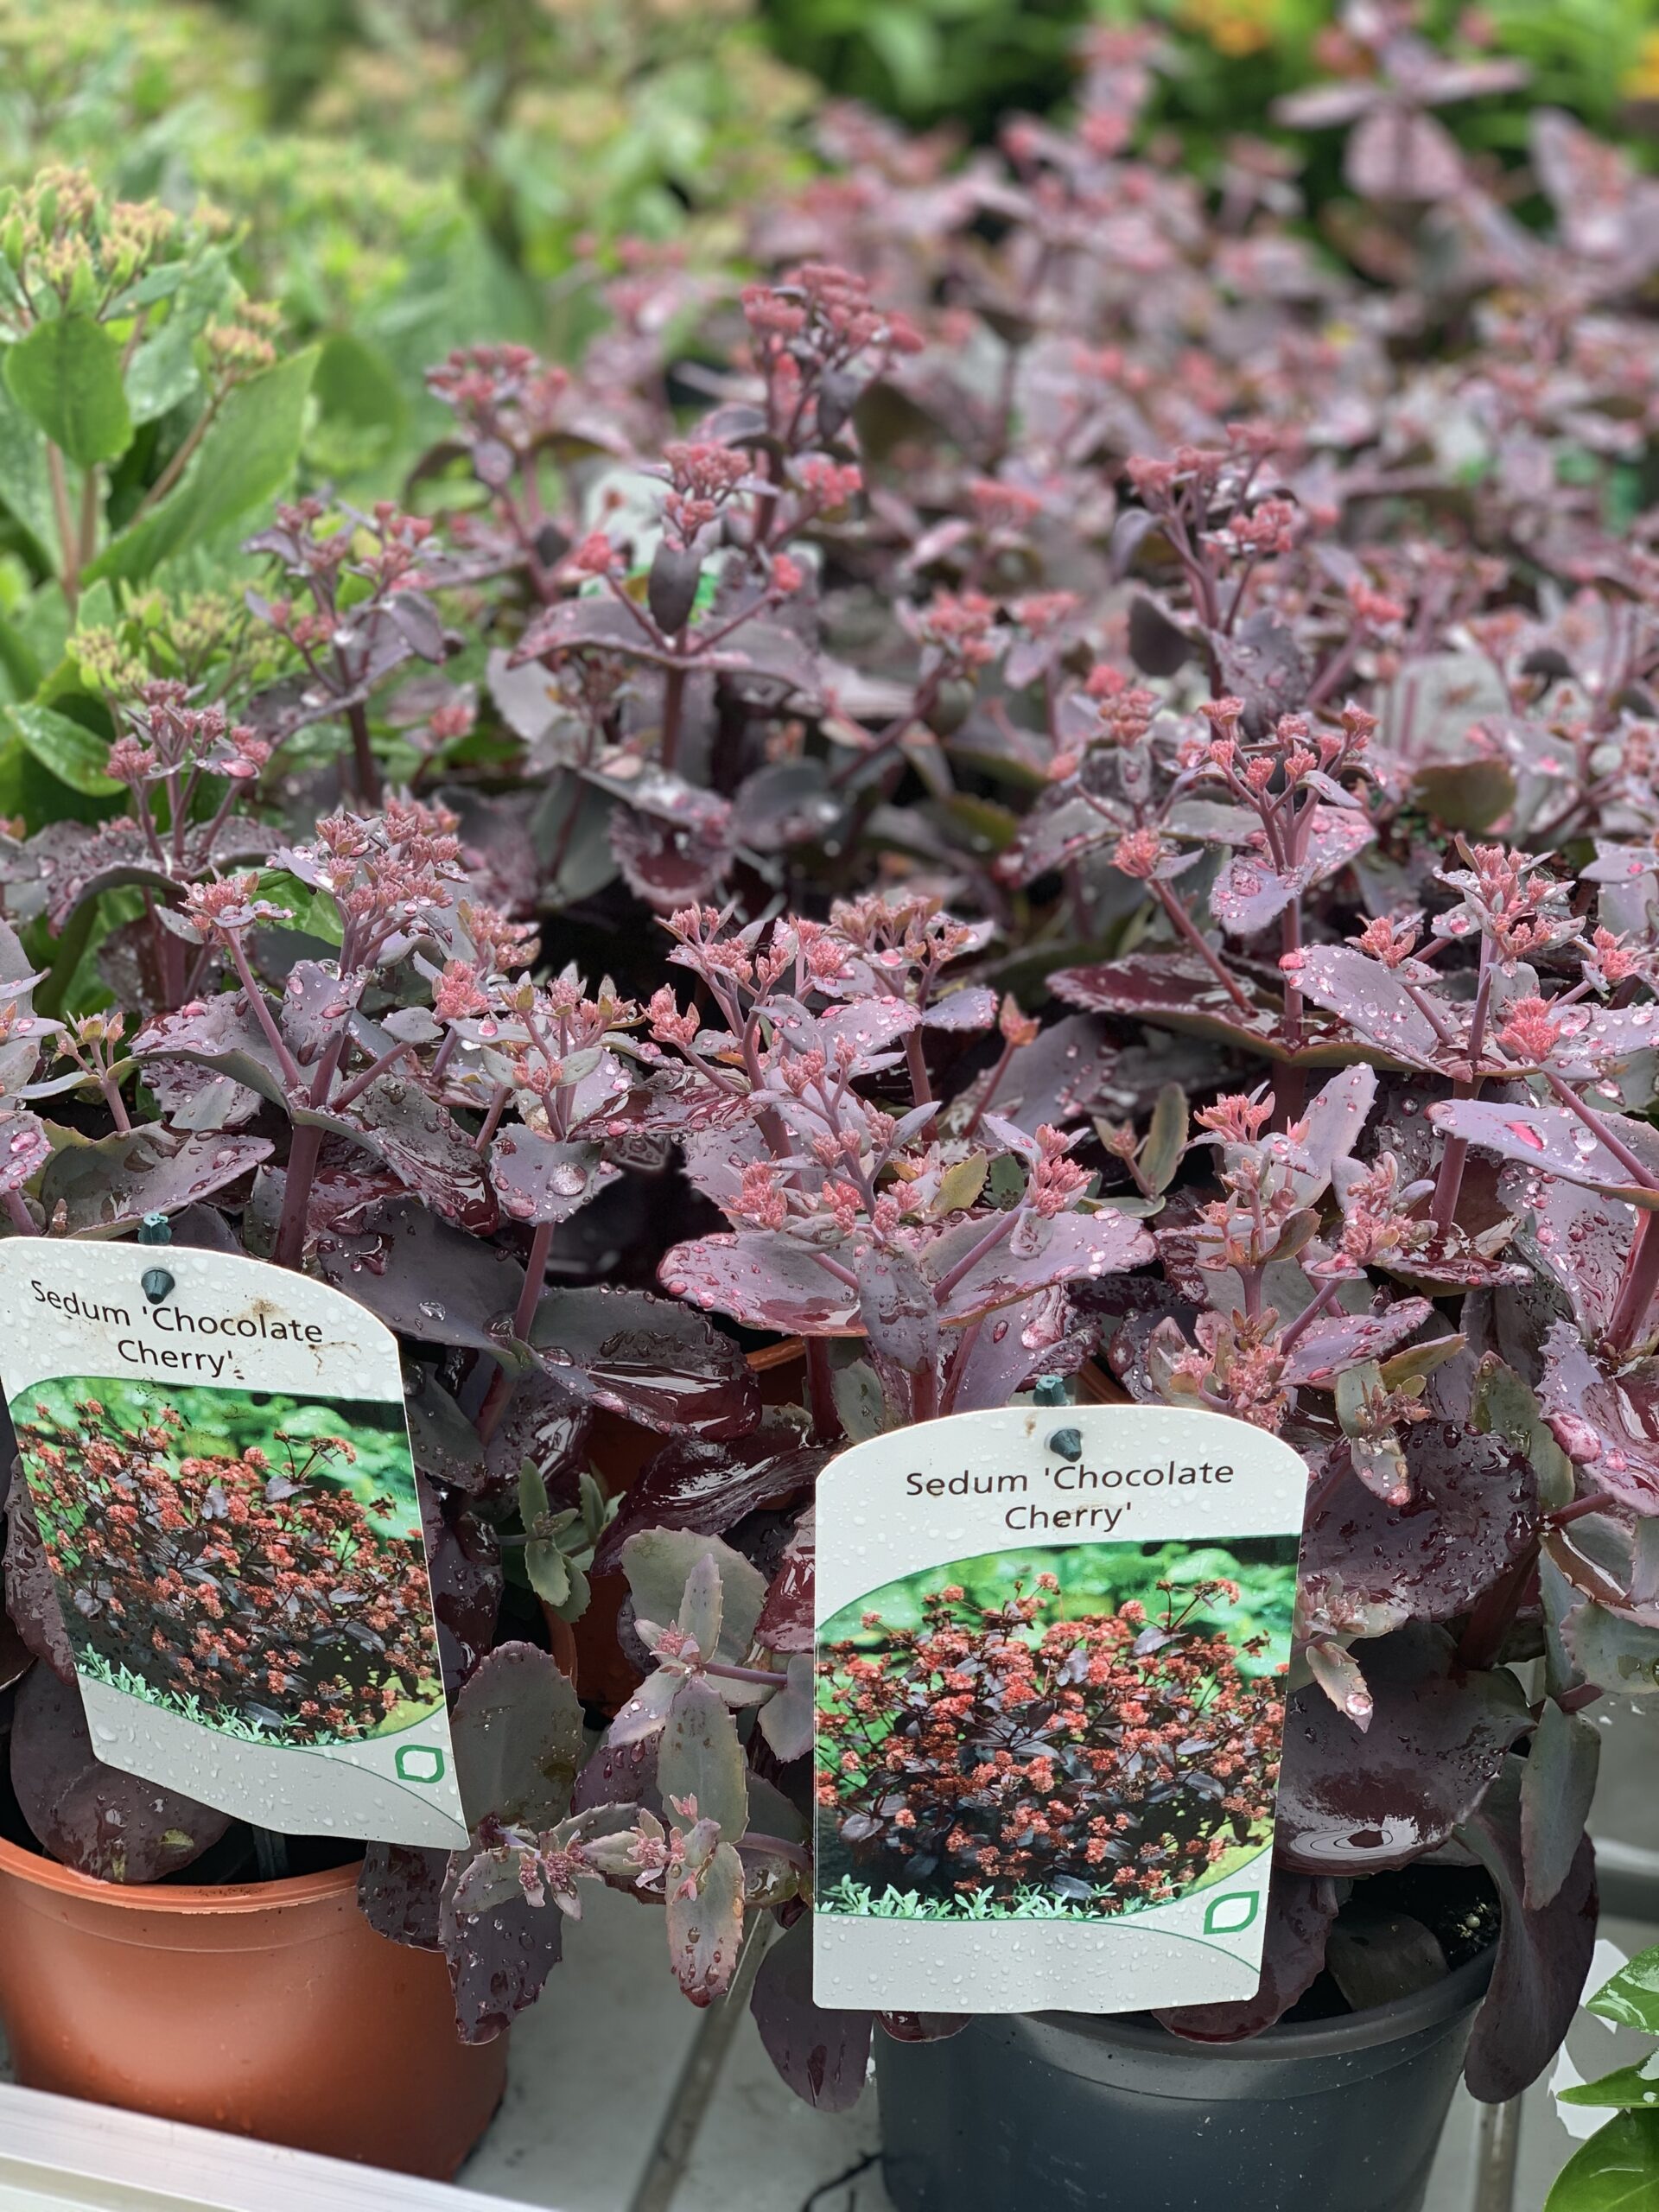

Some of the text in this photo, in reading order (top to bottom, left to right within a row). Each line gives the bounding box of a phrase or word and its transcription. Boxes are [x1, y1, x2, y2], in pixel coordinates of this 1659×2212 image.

[31, 1280, 323, 1343] Sedum 'Chocolate
[118, 1339, 233, 1378] Cherry'
[906, 1460, 1234, 1497] Sedum 'Chocolate
[1005, 1502, 1132, 1532] Cherry'
